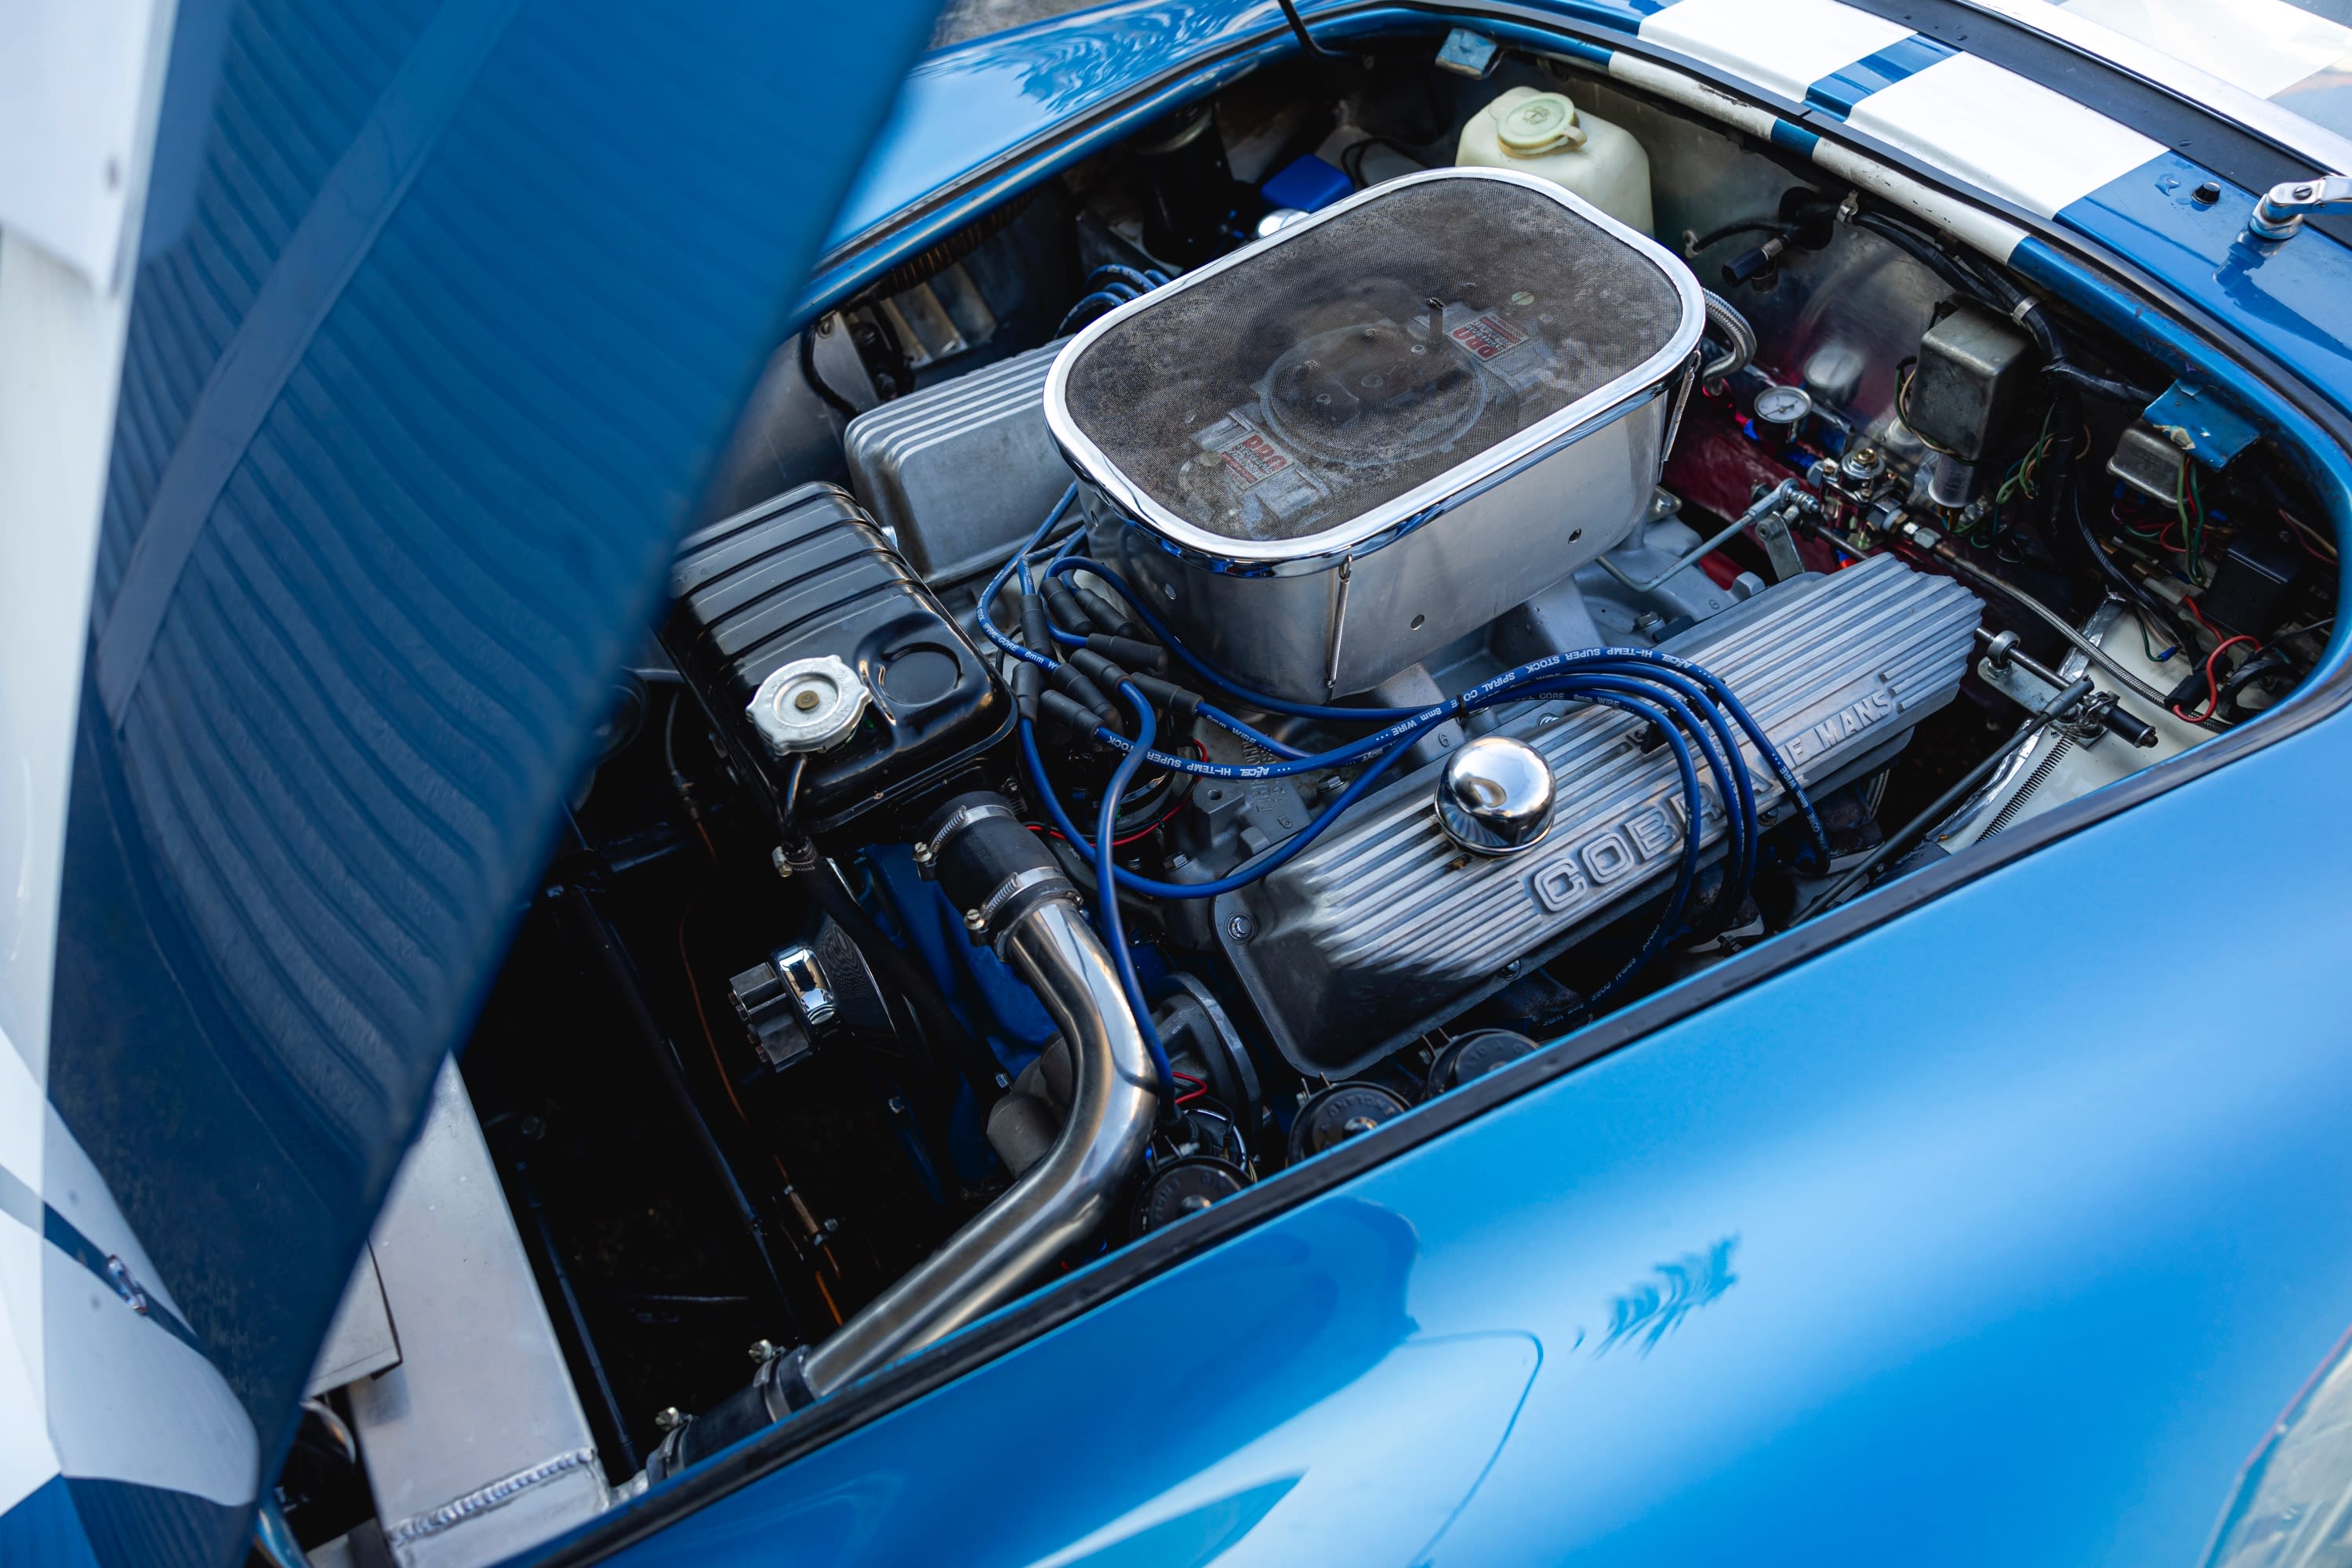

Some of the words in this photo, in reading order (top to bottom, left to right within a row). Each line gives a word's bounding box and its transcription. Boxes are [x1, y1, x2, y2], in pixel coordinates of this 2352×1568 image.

[997, 637, 1020, 652] CORE
[1024, 651, 1044, 664] 8mm
[1564, 648, 1601, 661] SUPER
[1606, 647, 1653, 659] HI-TEMP
[1525, 655, 1560, 674] STOCK
[1481, 671, 1516, 693] SPIRAL
[1450, 688, 1479, 710] COE
[1419, 706, 1443, 721] 8mm
[1813, 688, 1893, 750] MANS
[1390, 719, 1417, 737] WIRE
[1109, 735, 1136, 753] TOCK
[1145, 751, 1182, 768] SUPER
[1185, 764, 1232, 777] HI-TEMP
[1779, 764, 1798, 790] WIRE
